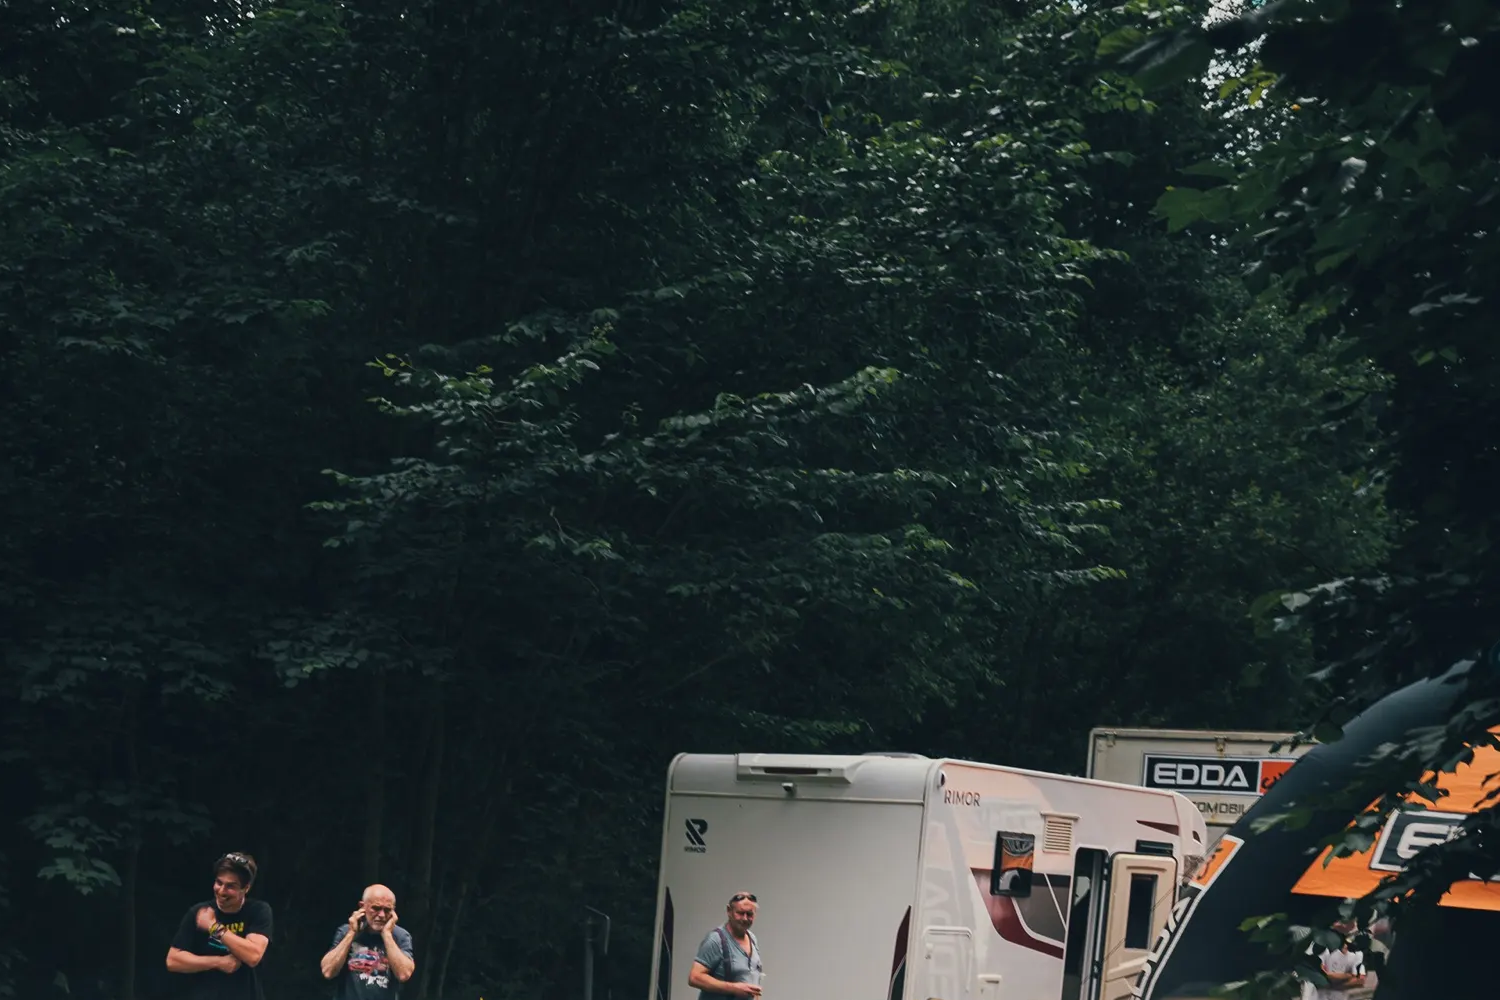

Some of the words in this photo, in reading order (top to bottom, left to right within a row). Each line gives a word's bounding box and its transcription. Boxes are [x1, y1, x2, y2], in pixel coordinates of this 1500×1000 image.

[1153, 763, 1249, 788] EDDA
[944, 789, 981, 807] RIMOR
[1192, 800, 1246, 815] OMOBIL
